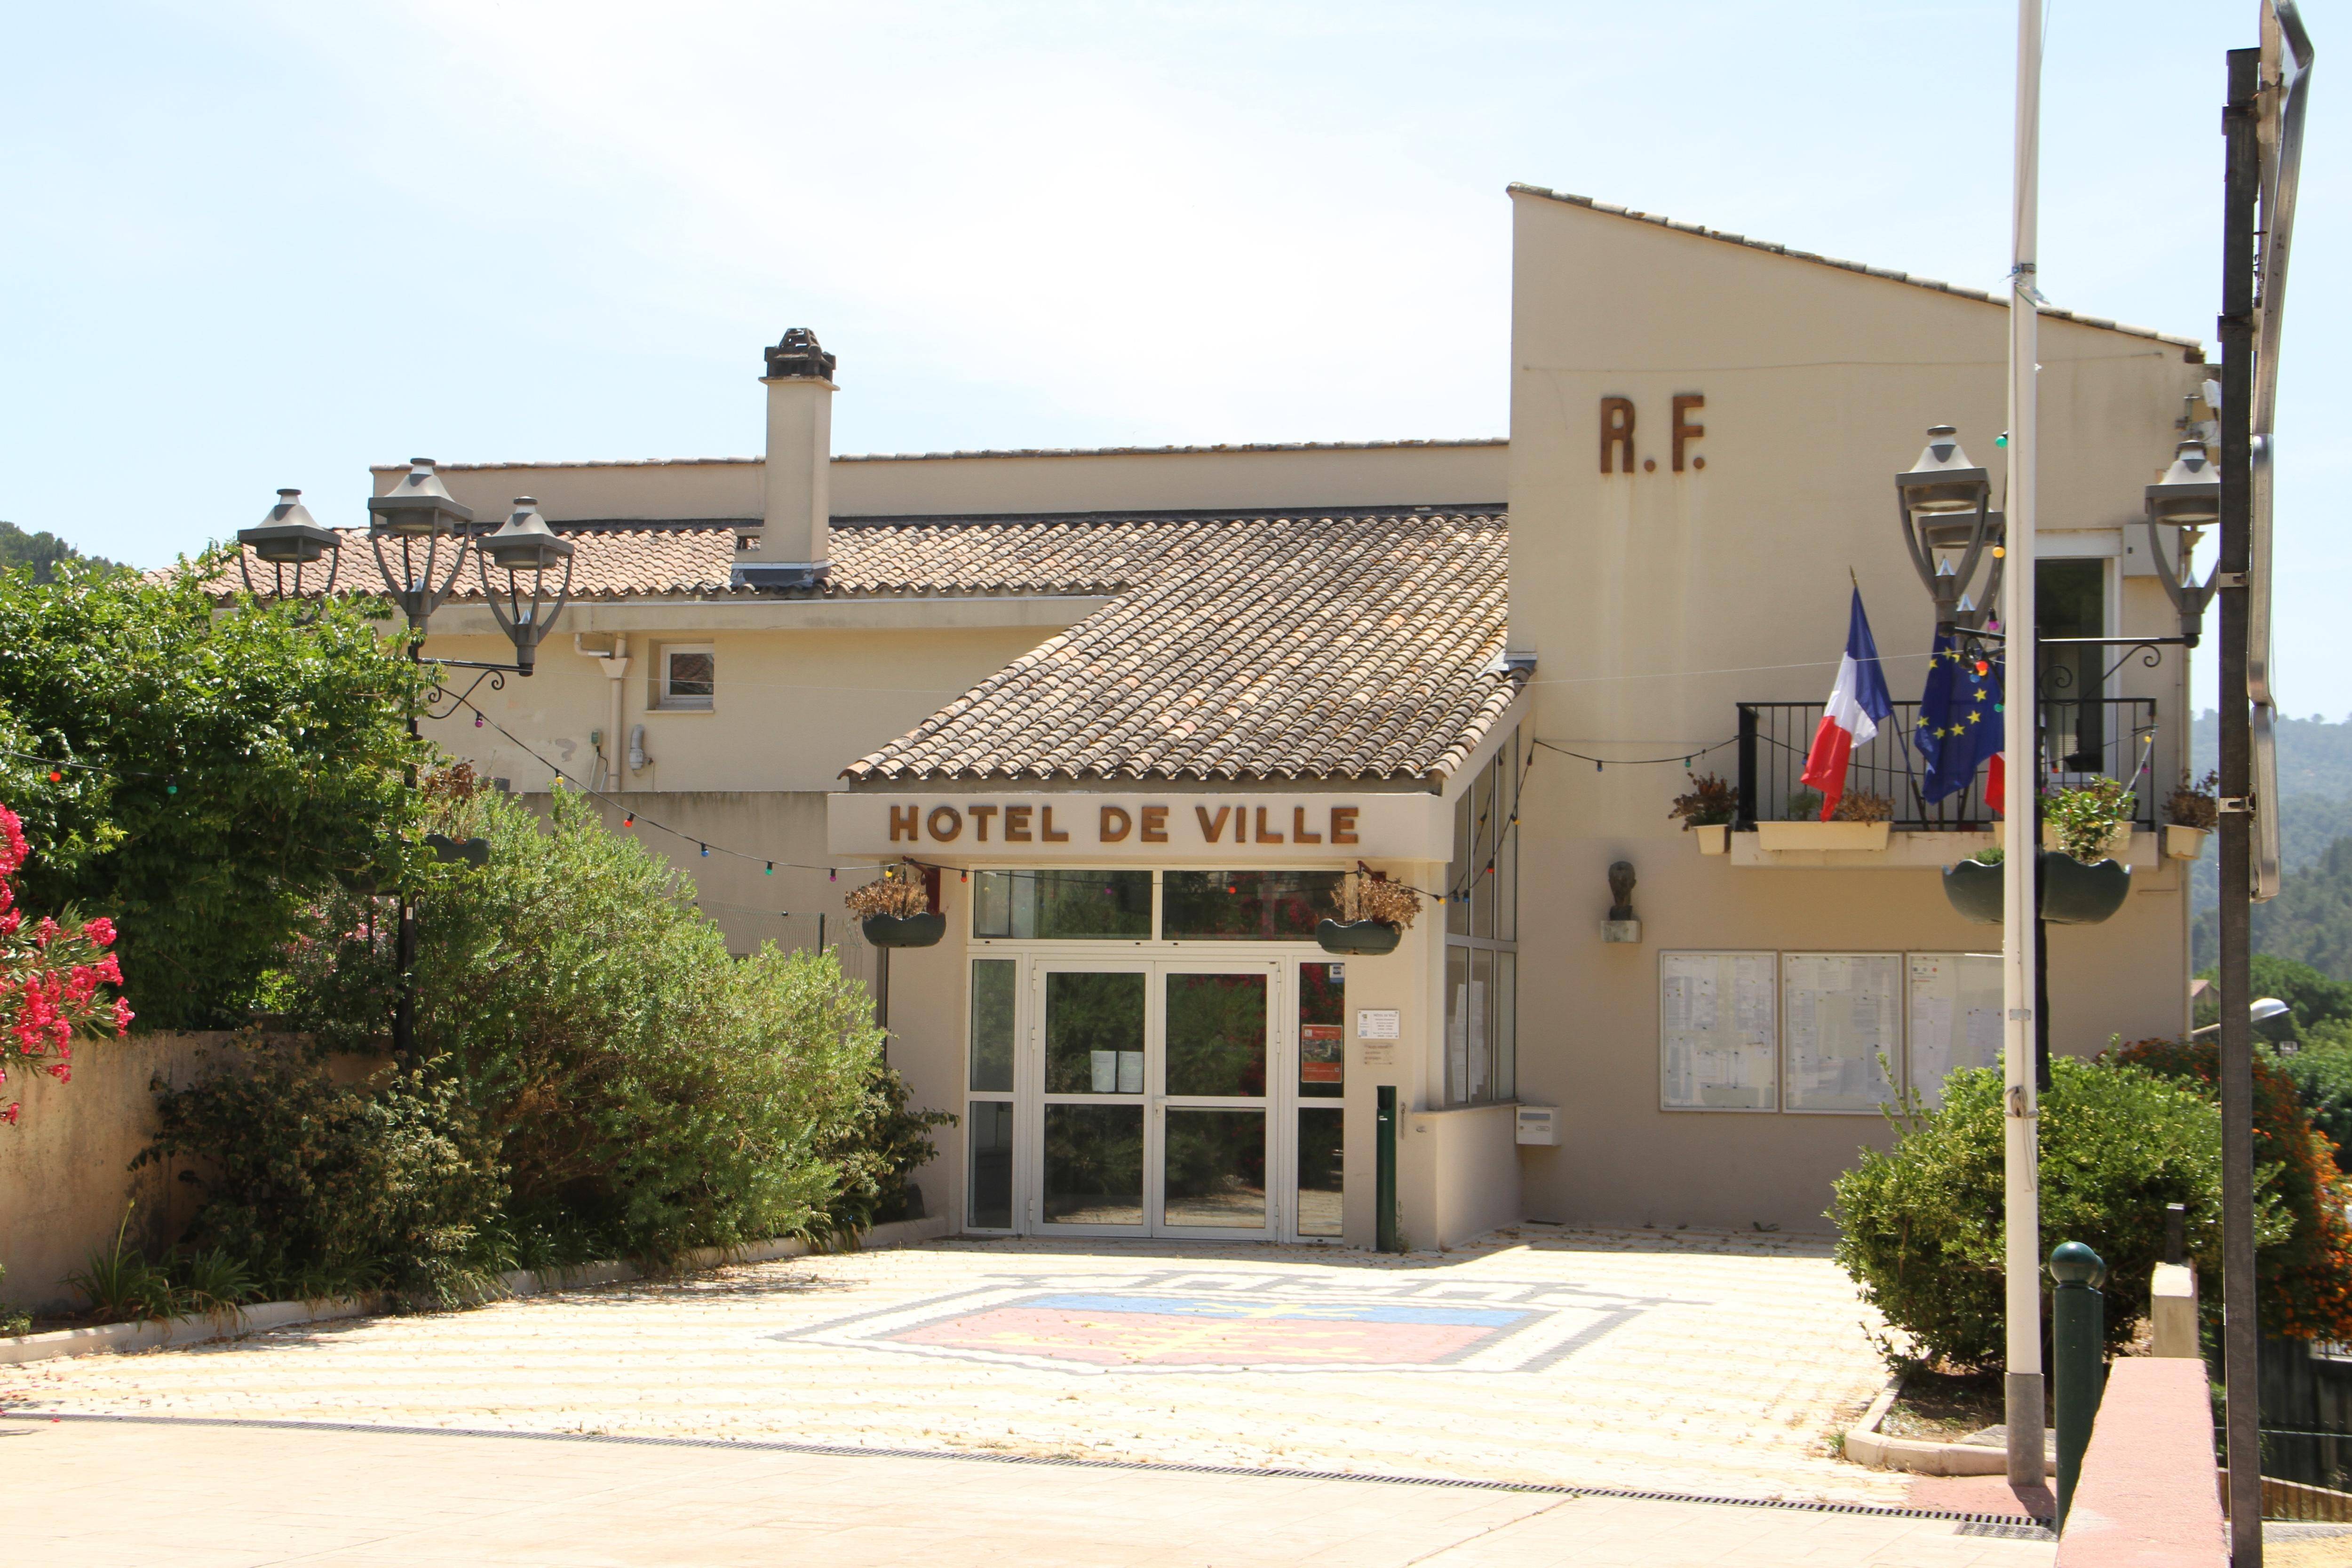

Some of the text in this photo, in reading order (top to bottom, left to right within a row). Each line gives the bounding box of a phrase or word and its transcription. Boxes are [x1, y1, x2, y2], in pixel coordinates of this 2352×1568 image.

[890, 805, 1359, 844] HOTEL DE VILLE
